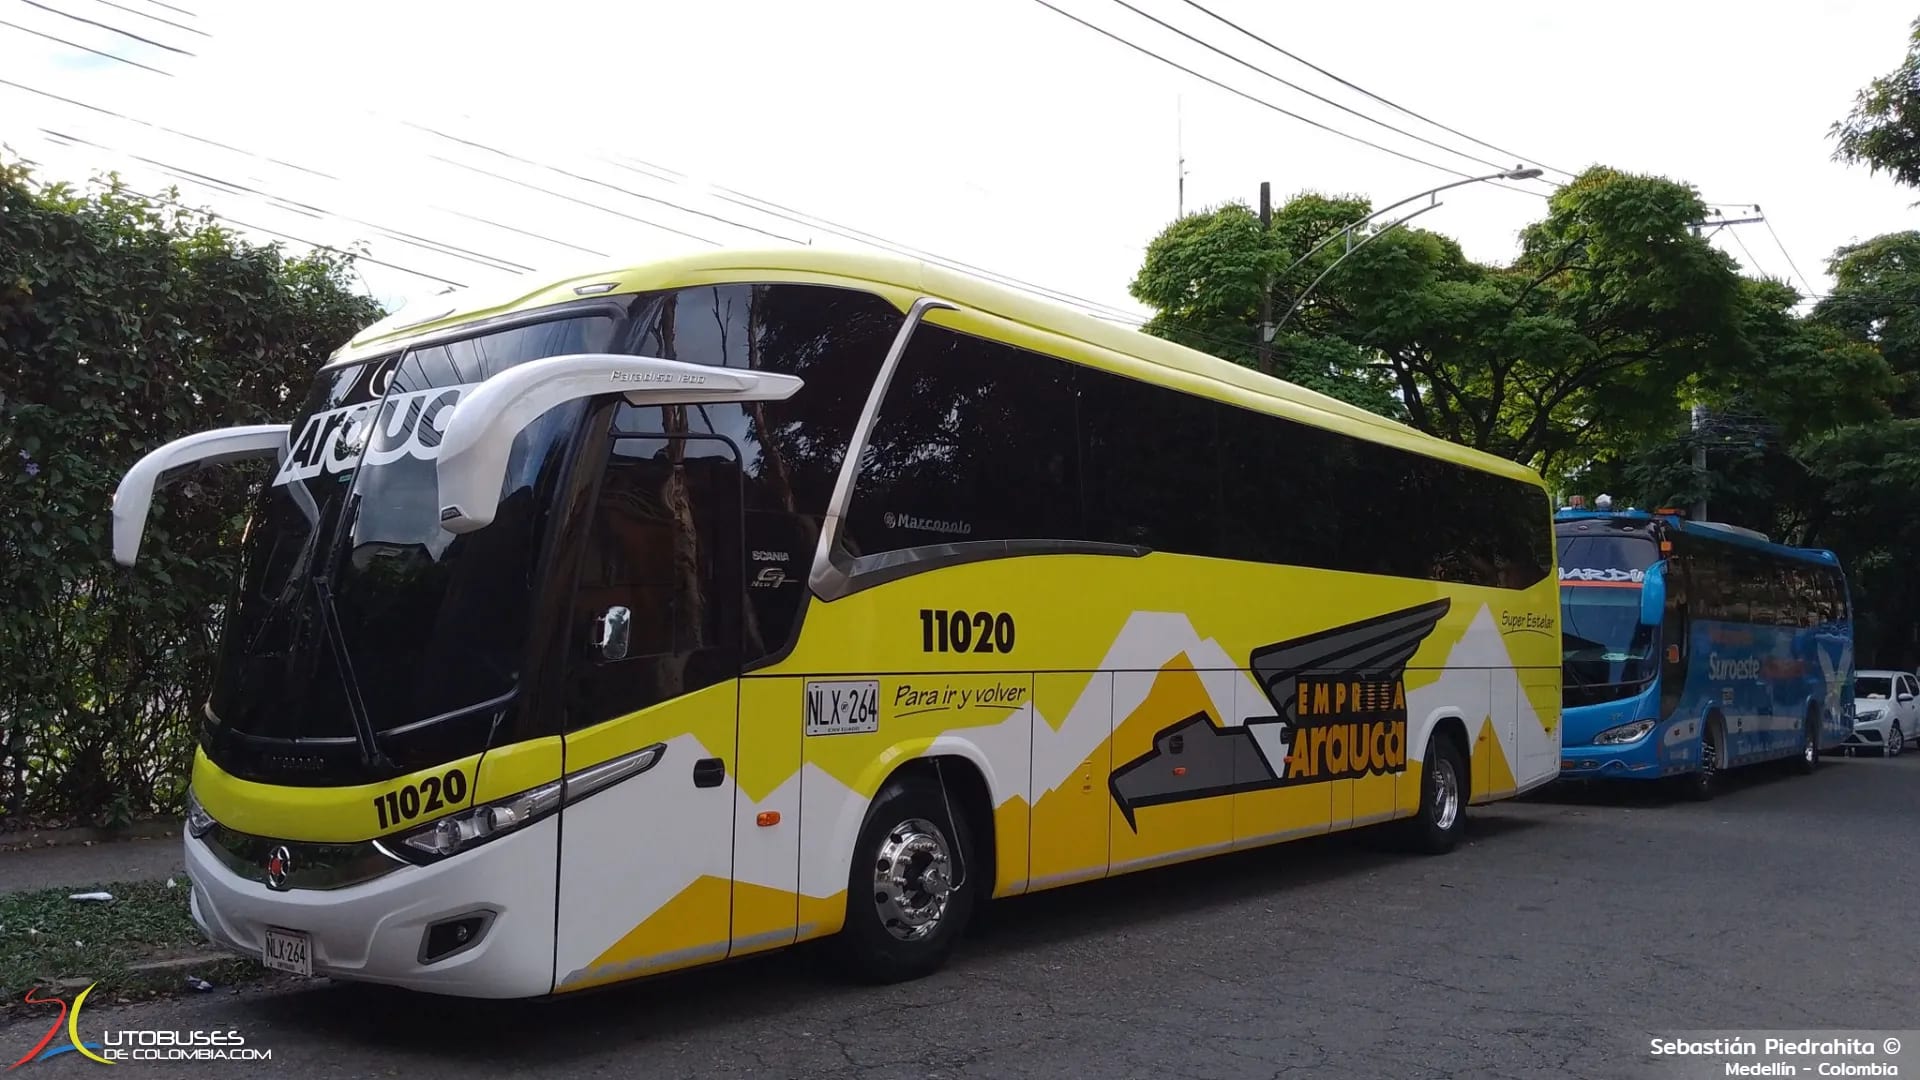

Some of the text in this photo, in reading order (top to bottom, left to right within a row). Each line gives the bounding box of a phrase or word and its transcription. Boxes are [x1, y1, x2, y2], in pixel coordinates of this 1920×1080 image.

[610, 369, 674, 383] Paradiso
[275, 385, 466, 481] Arauc
[897, 512, 972, 534] Marcopolo
[751, 550, 790, 561] SCANIA
[919, 609, 1016, 654] 11020
[1501, 609, 1555, 632] Super Estelar
[1708, 651, 1760, 681] Suroeste
[807, 688, 877, 726] NLX 264
[893, 682, 1027, 710] Para ir y volver
[1287, 720, 1406, 779] Arauca
[373, 768, 467, 830] 11020
[266, 936, 306, 966] NLX 264
